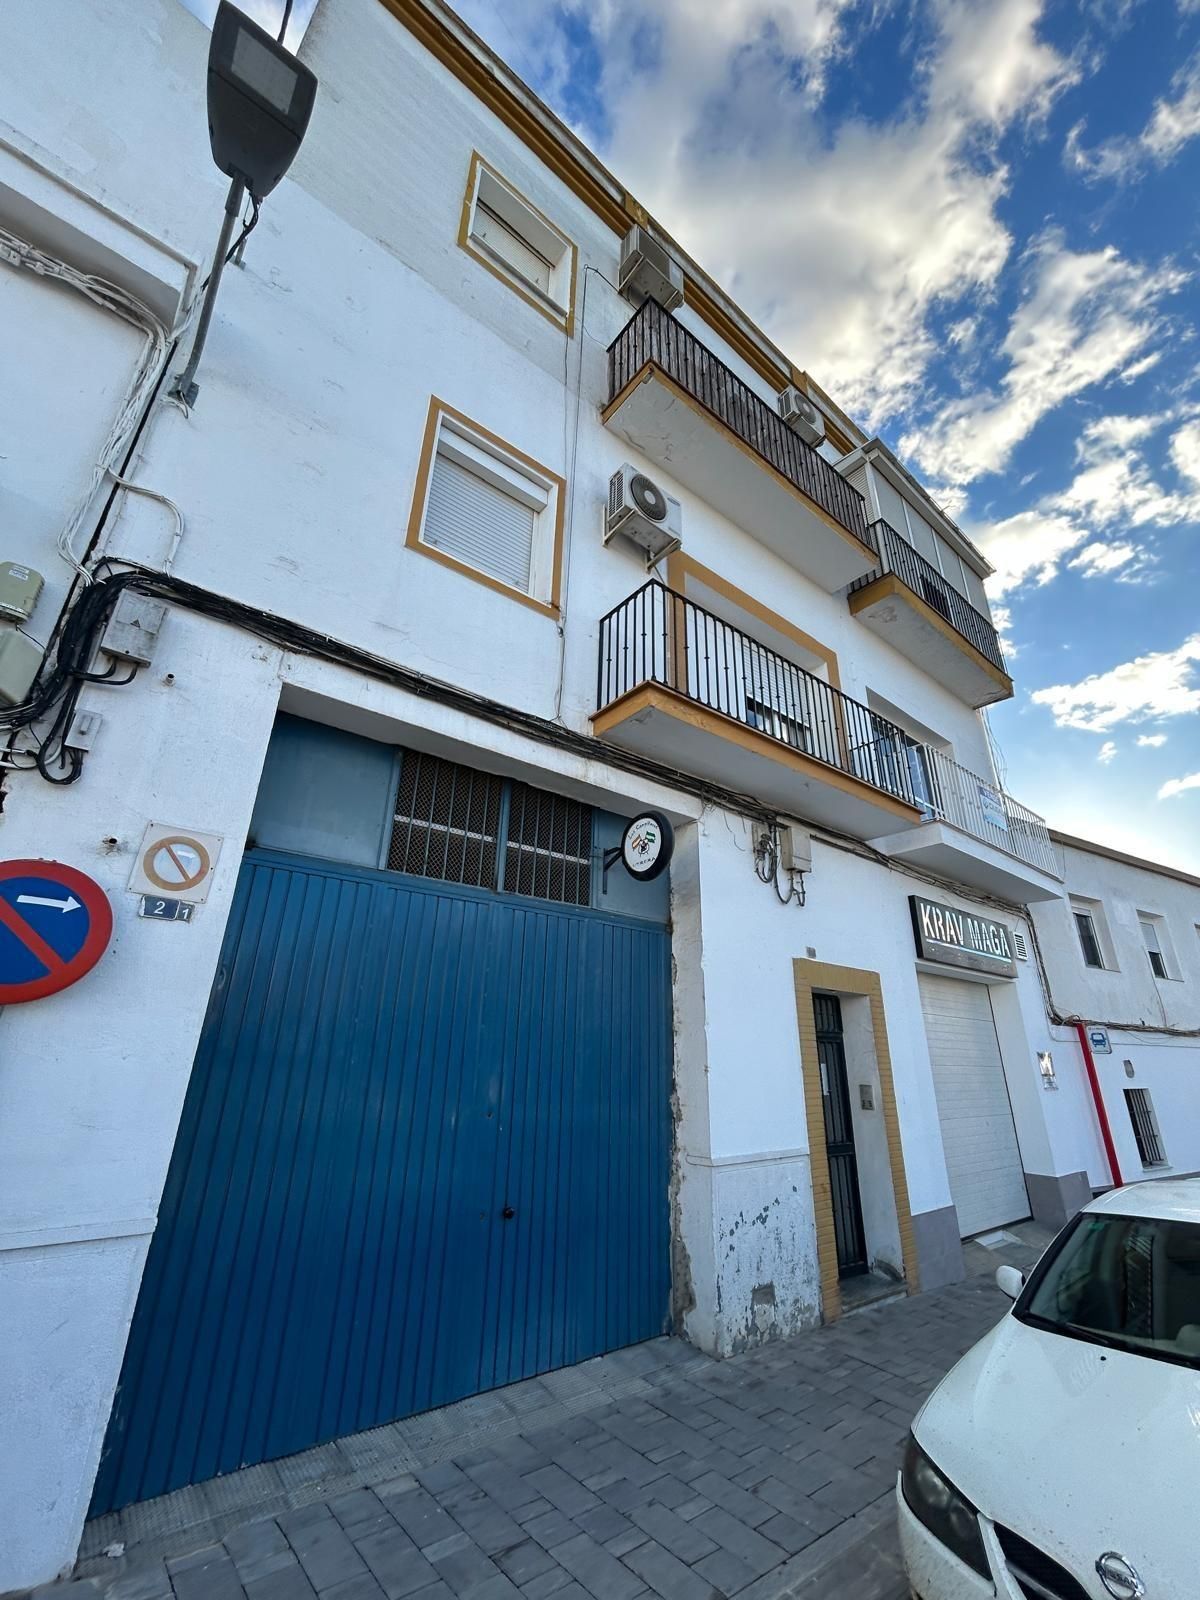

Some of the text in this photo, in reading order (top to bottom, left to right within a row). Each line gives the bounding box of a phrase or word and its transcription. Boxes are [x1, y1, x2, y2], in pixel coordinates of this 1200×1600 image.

[154, 901, 190, 919] 2 1
[920, 903, 1011, 957] KRAV MAGA
